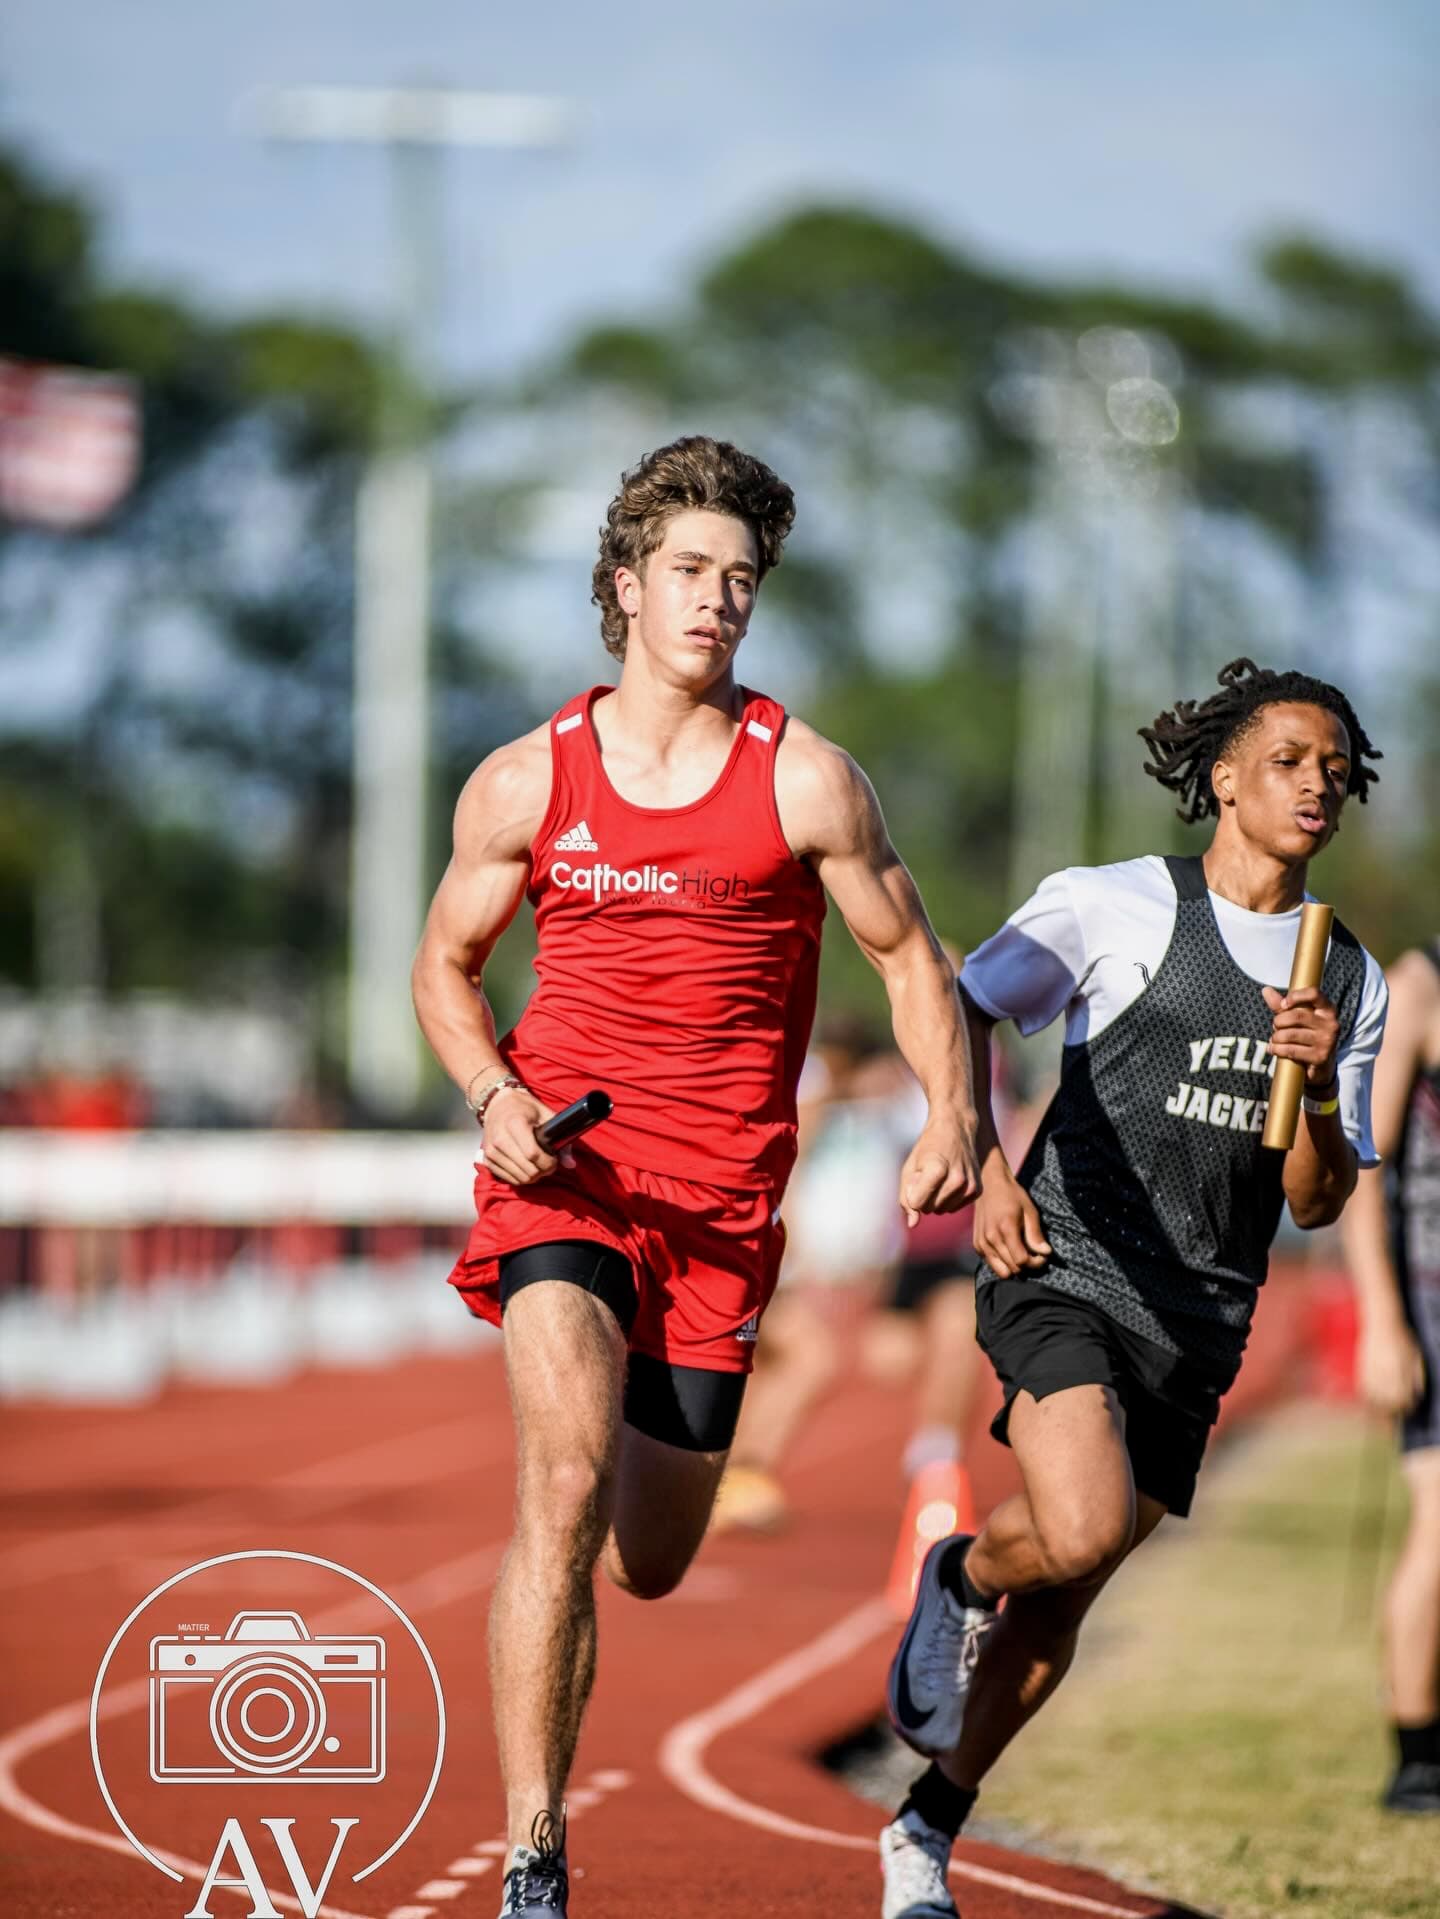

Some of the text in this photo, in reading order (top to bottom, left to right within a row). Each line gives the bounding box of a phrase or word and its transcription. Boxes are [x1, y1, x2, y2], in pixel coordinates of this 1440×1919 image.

[554, 839, 599, 852] adidas
[551, 861, 750, 903] Catholic High
[1165, 1082, 1270, 1133] JACKE
